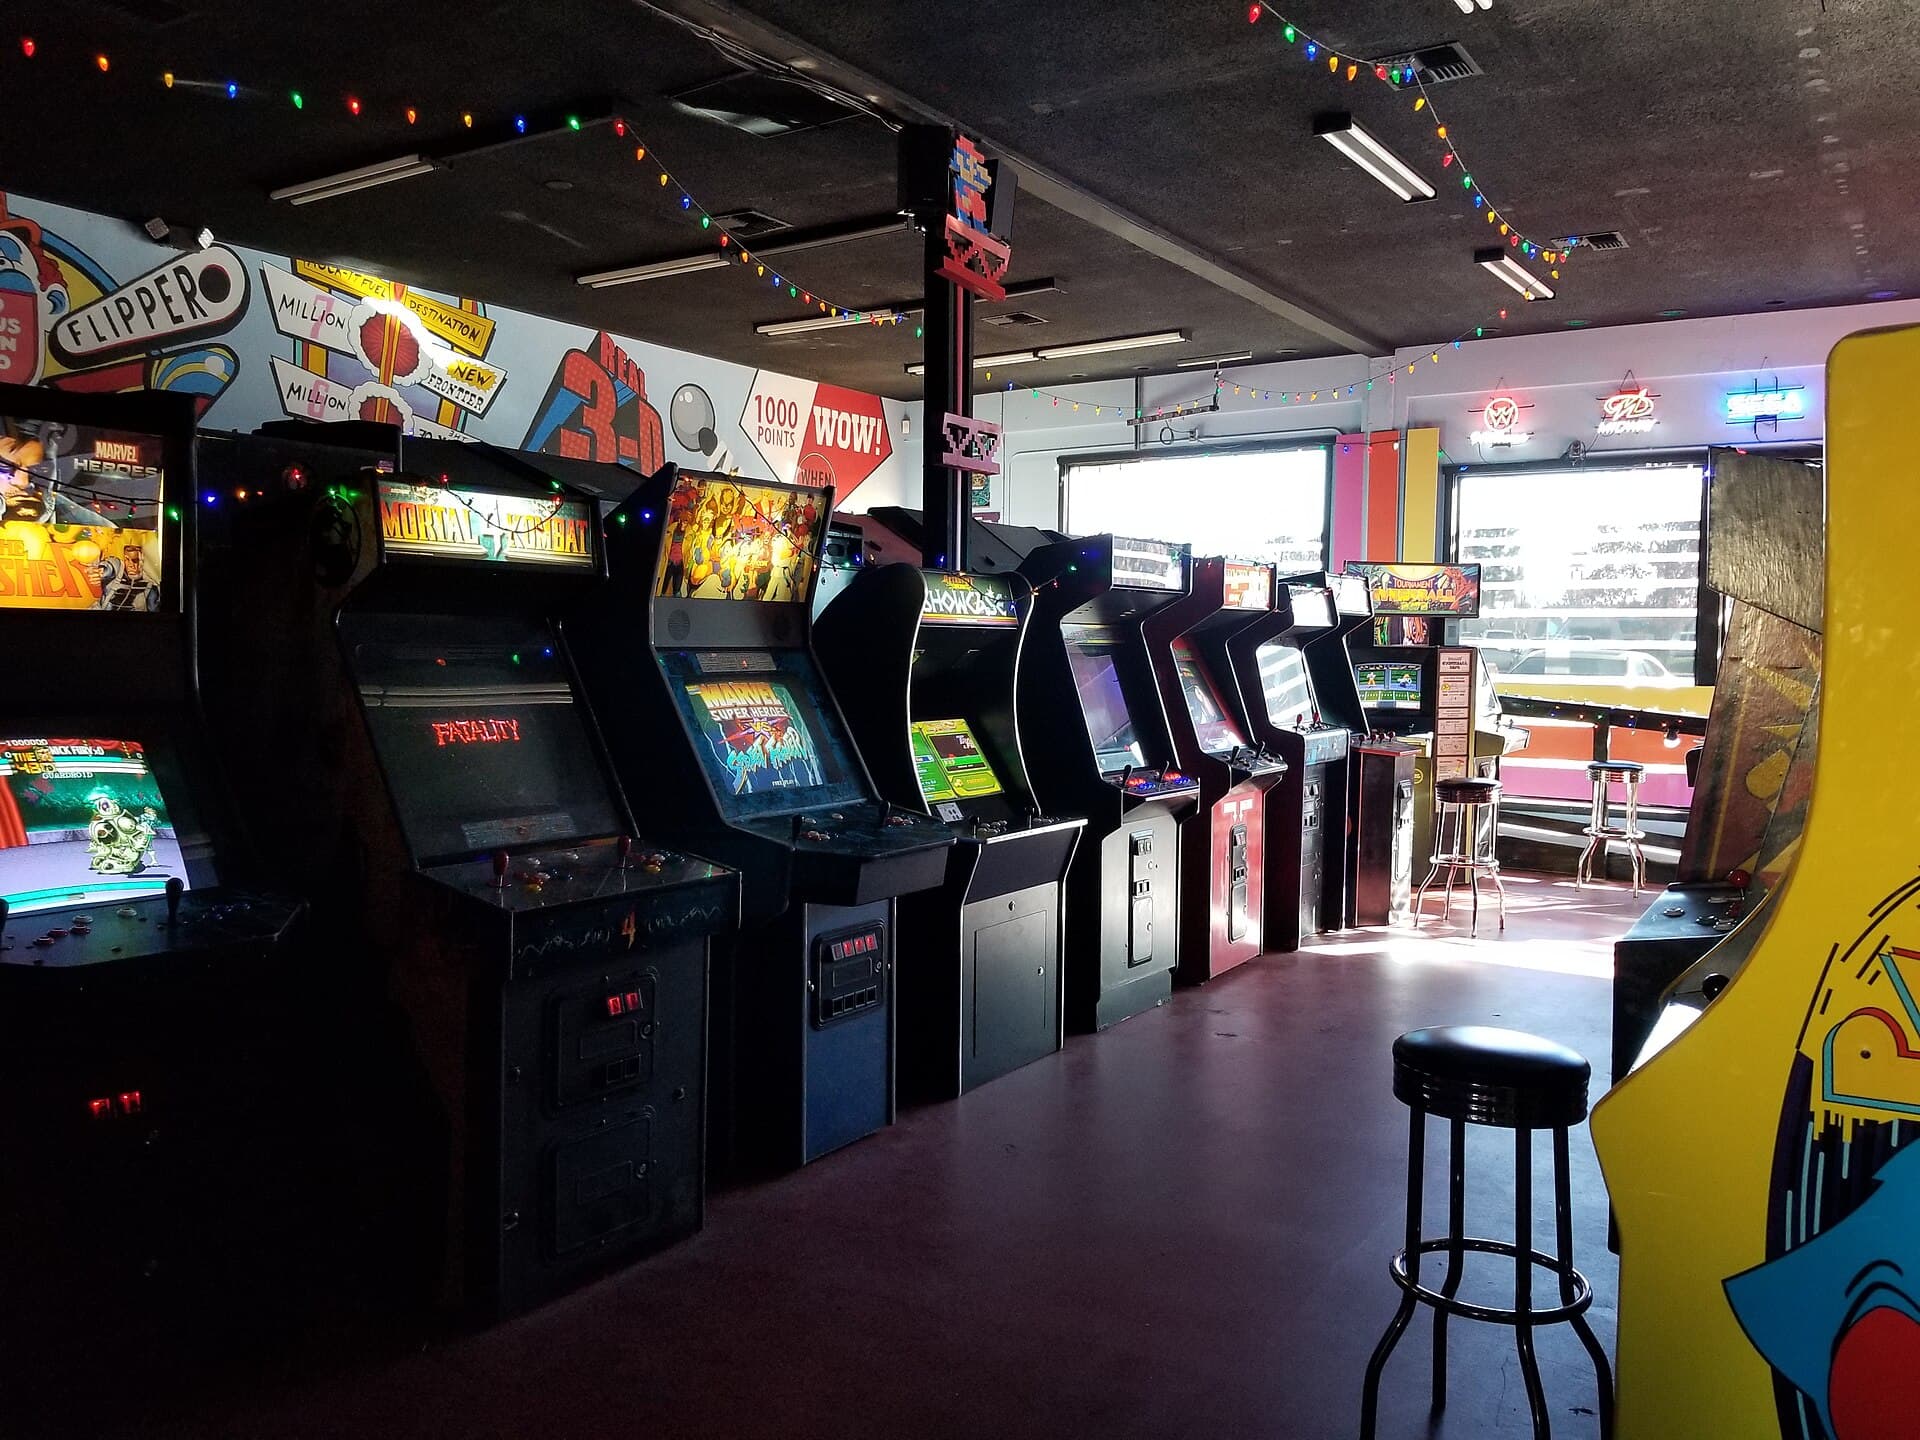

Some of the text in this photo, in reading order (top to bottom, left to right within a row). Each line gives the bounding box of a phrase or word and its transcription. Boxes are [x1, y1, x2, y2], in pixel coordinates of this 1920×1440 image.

[66, 264, 208, 347] FLIPPER
[278, 293, 346, 330] MILLION
[409, 299, 482, 342] DESTINATION
[454, 366, 492, 387] NEW
[600, 331, 648, 400] REAL
[286, 382, 347, 412] MILLION
[427, 373, 484, 412] FRONTIER
[755, 394, 798, 429] 1000
[758, 426, 795, 448] POINTS
[813, 405, 883, 456] WOW!
[95, 440, 139, 462] MARVEL
[73, 458, 158, 478] HEROES
[801, 469, 831, 487] WHEN
[380, 502, 480, 545] MORTAL
[506, 513, 588, 554] KOMBAT
[1393, 577, 1434, 589] TOURNAMENT
[700, 682, 783, 708] MARVEL
[710, 706, 789, 721] SUPER HEROES
[431, 718, 521, 746] FATALITY
